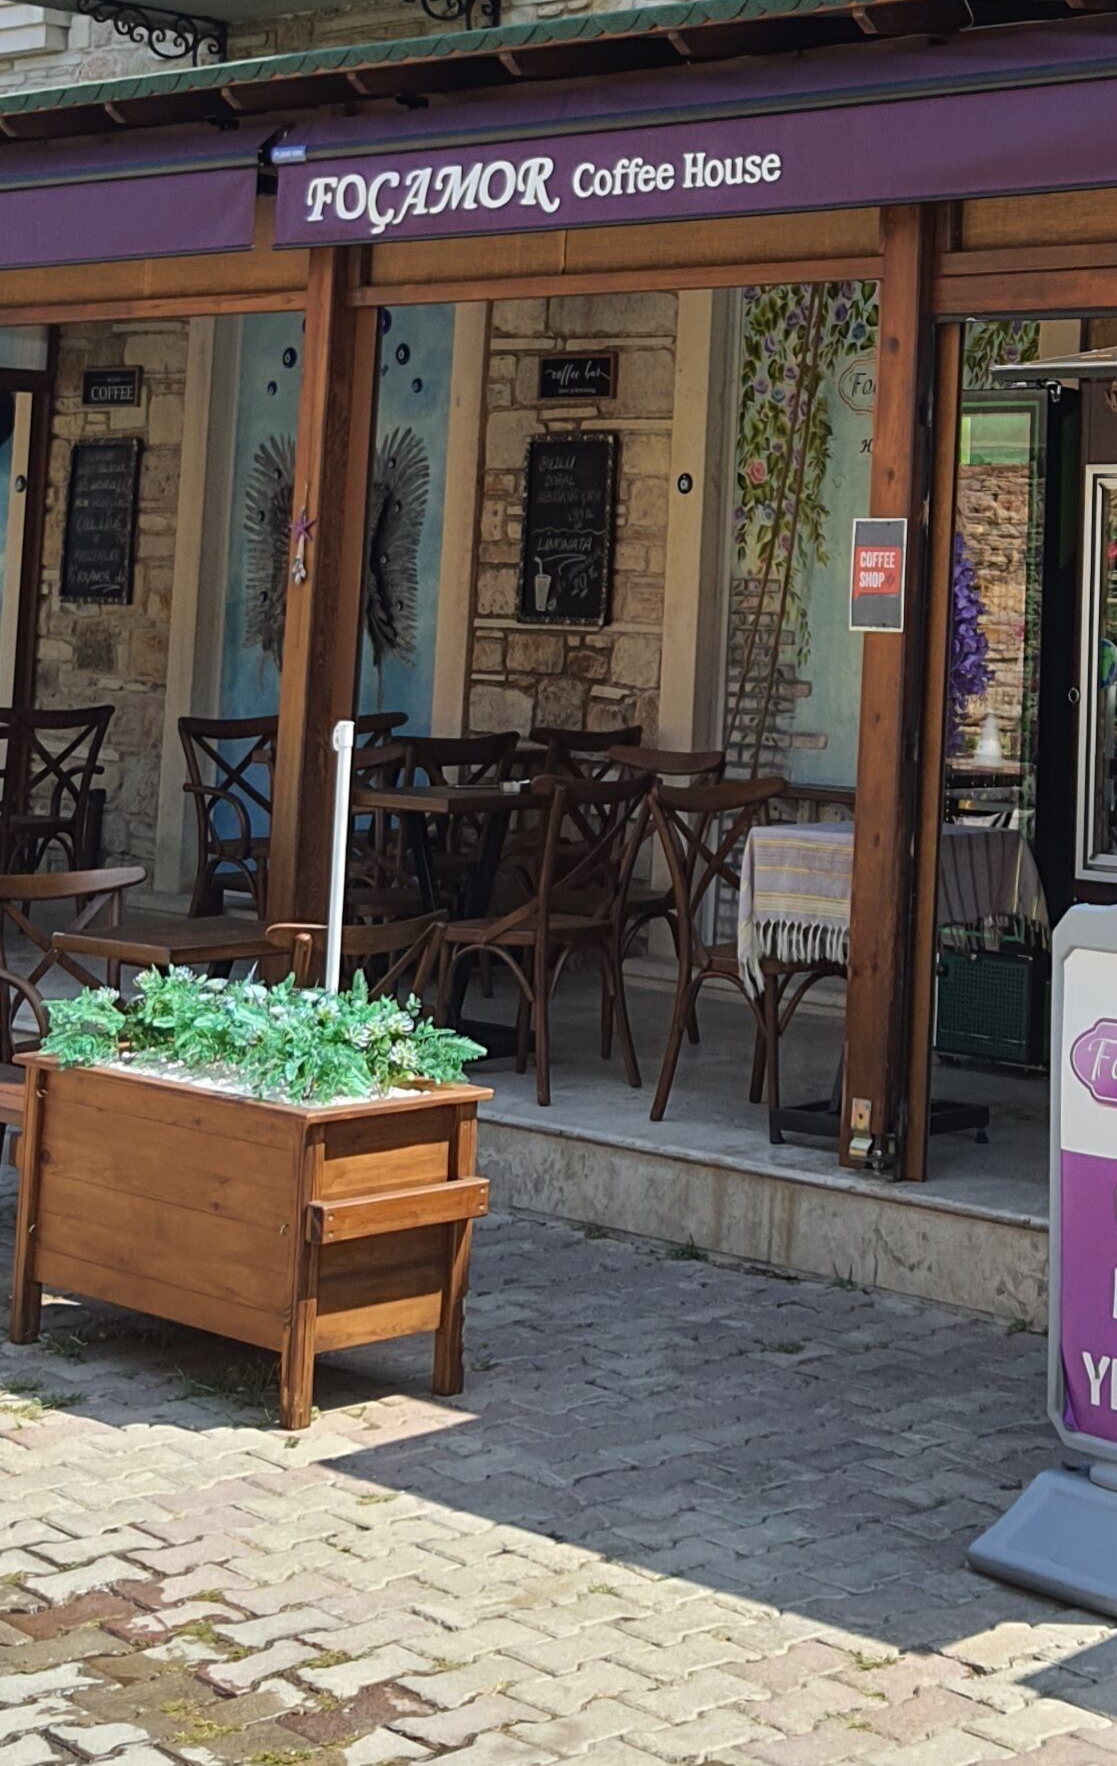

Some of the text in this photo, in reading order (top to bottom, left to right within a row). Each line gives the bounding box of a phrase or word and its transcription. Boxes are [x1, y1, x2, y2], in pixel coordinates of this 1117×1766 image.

[306, 151, 783, 234] FOÇAMOR Coffee House
[91, 385, 135, 401] COFFEE
[860, 551, 895, 568] COFFEE
[859, 572, 885, 588] SHOP
